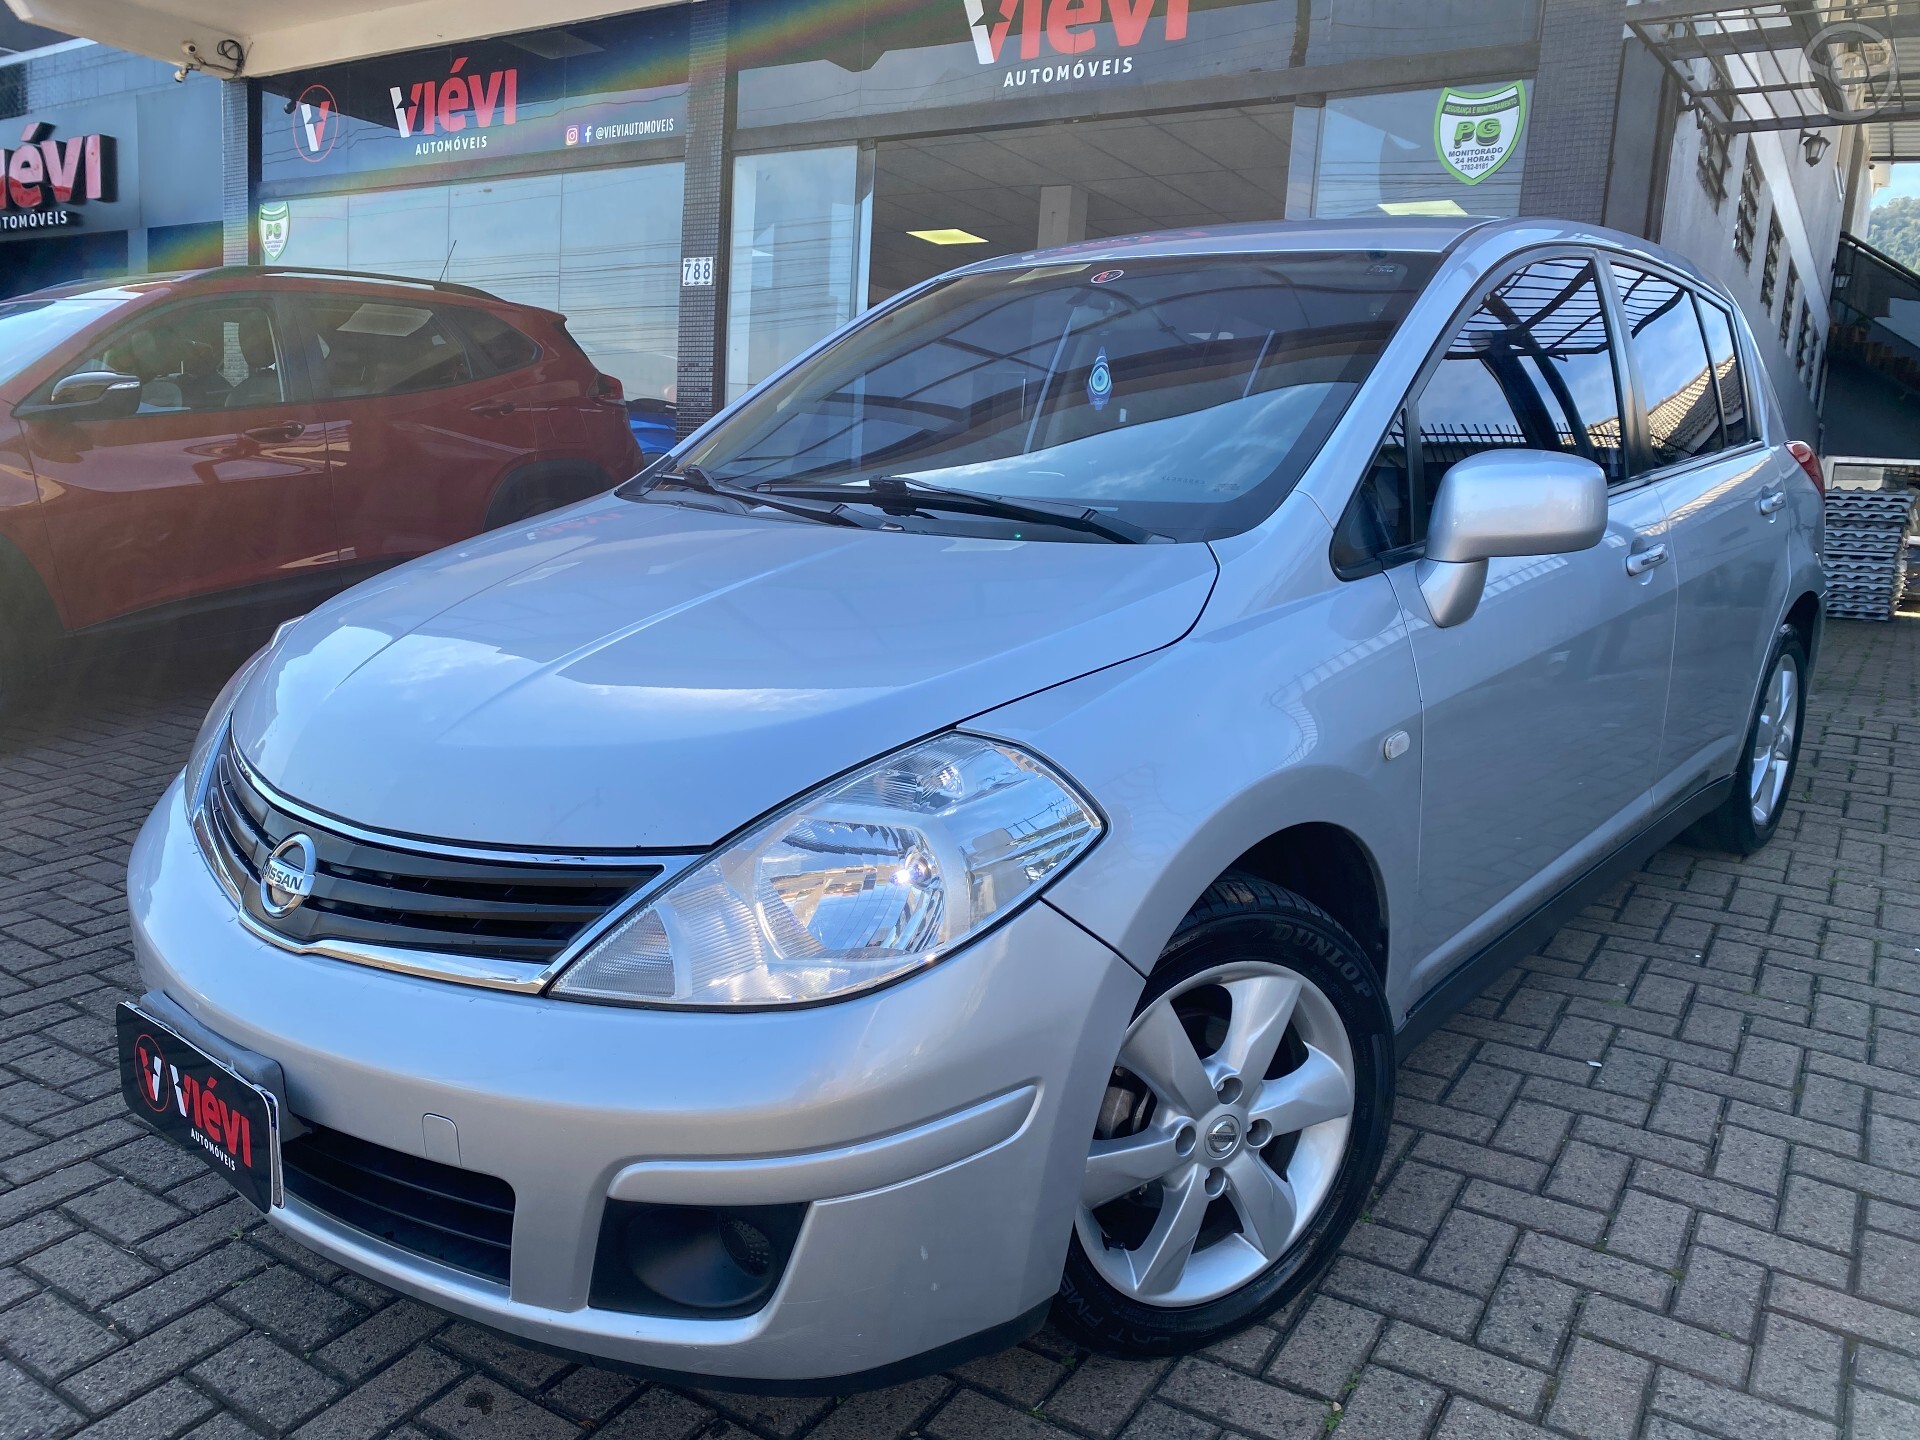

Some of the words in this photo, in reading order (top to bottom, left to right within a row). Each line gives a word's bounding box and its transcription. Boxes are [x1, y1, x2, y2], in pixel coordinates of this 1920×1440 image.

[1003, 57, 1133, 88] AUTOMÓVEIS
[595, 118, 674, 140] @VIEVIAUTOMOVEIS
[1453, 118, 1502, 149] PG
[415, 135, 488, 156] AUTOMÓVEIS
[1448, 146, 1504, 158] MONITORADO
[1454, 157, 1465, 165] 24
[1466, 154, 1496, 164] HORAS
[0, 209, 68, 230] TOMÓVEIS
[684, 262, 711, 281] 788
[262, 862, 304, 891] NISSAN
[1271, 922, 1373, 998] DUNLOP
[190, 1127, 236, 1172] AUTOMÓVEIS
